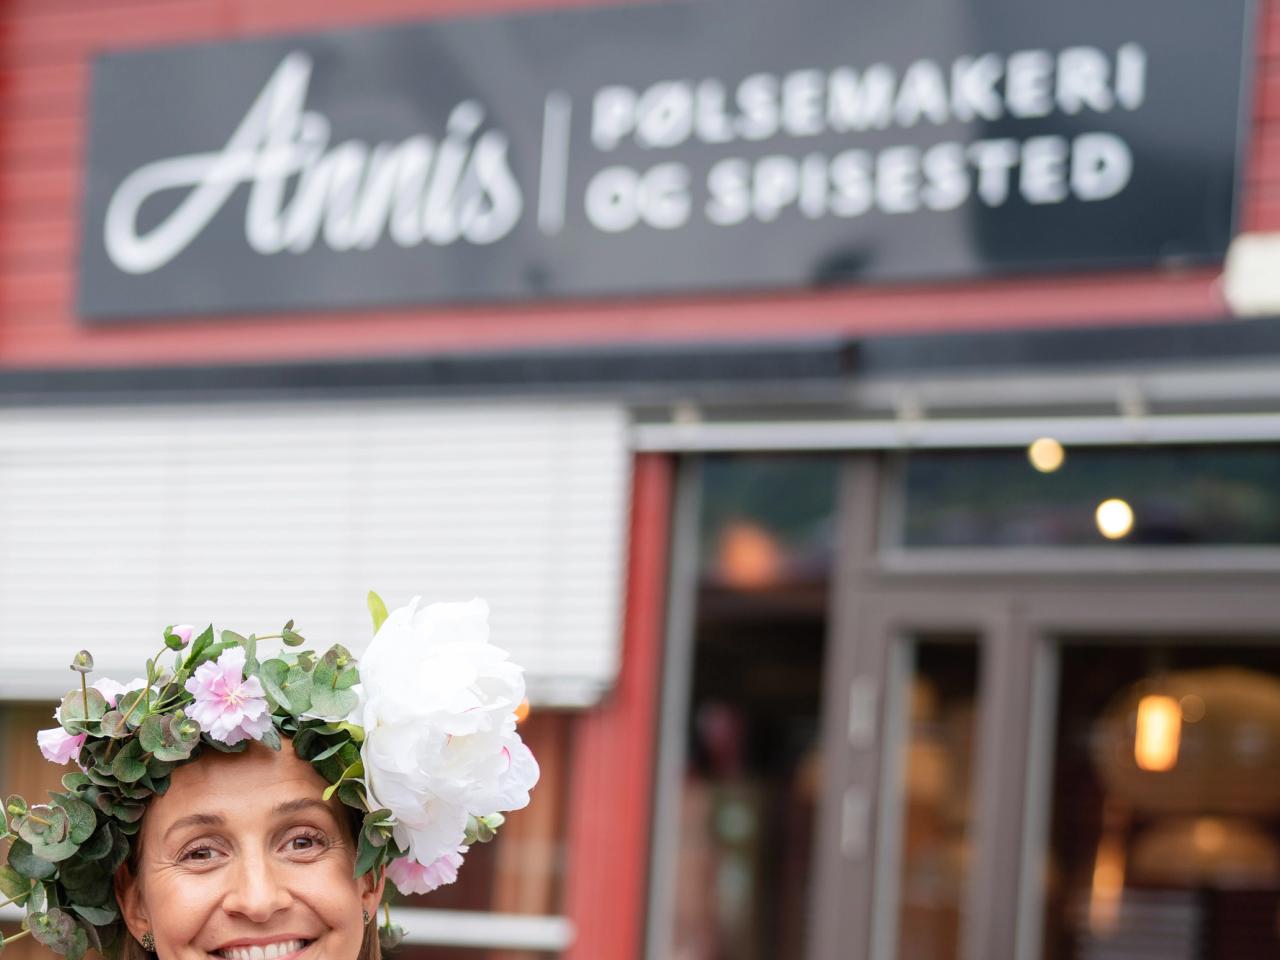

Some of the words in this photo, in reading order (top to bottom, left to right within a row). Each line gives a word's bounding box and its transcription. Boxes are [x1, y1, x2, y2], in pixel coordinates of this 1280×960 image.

[591, 43, 1147, 150] PØLSEMAKERI
[104, 50, 523, 274] Annis
[584, 163, 690, 233] OG
[706, 131, 1134, 227] SPISESTED
